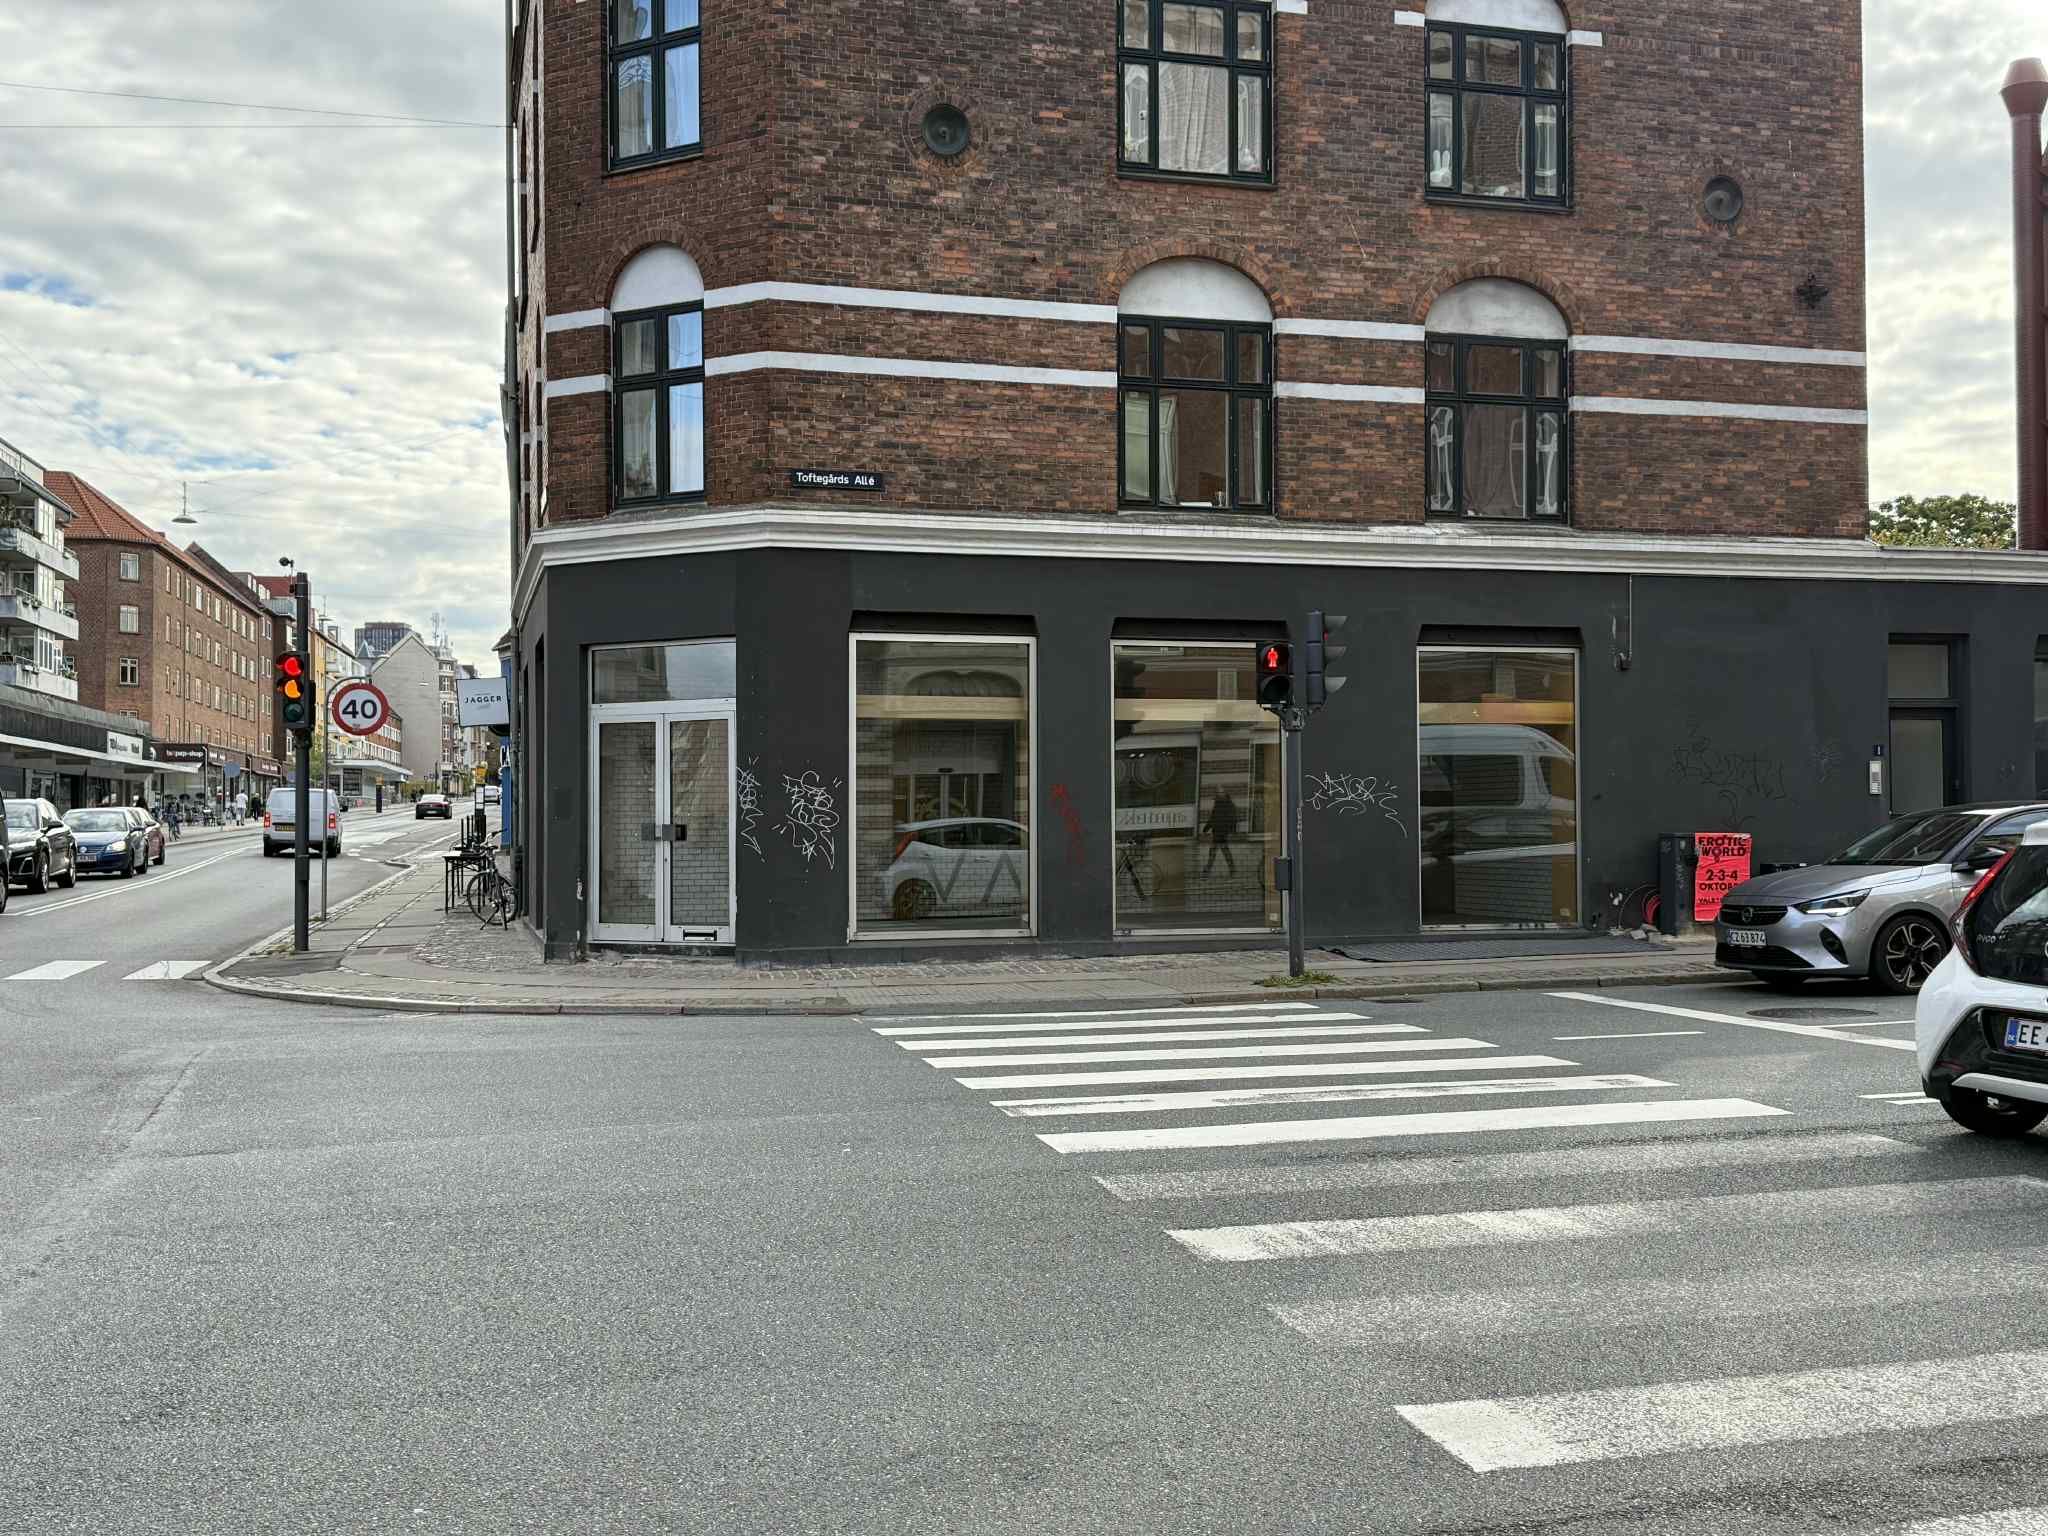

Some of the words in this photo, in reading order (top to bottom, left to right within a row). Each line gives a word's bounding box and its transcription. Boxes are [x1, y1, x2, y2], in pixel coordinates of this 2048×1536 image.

[796, 472, 849, 485] Toftegårds
[855, 475, 875, 486] Allé
[465, 695, 502, 704] JAGGER
[342, 699, 378, 719] 40
[1698, 836, 1747, 847] EROTIC
[1702, 846, 1746, 857] WORLD
[1706, 869, 1738, 881] 2-3-4
